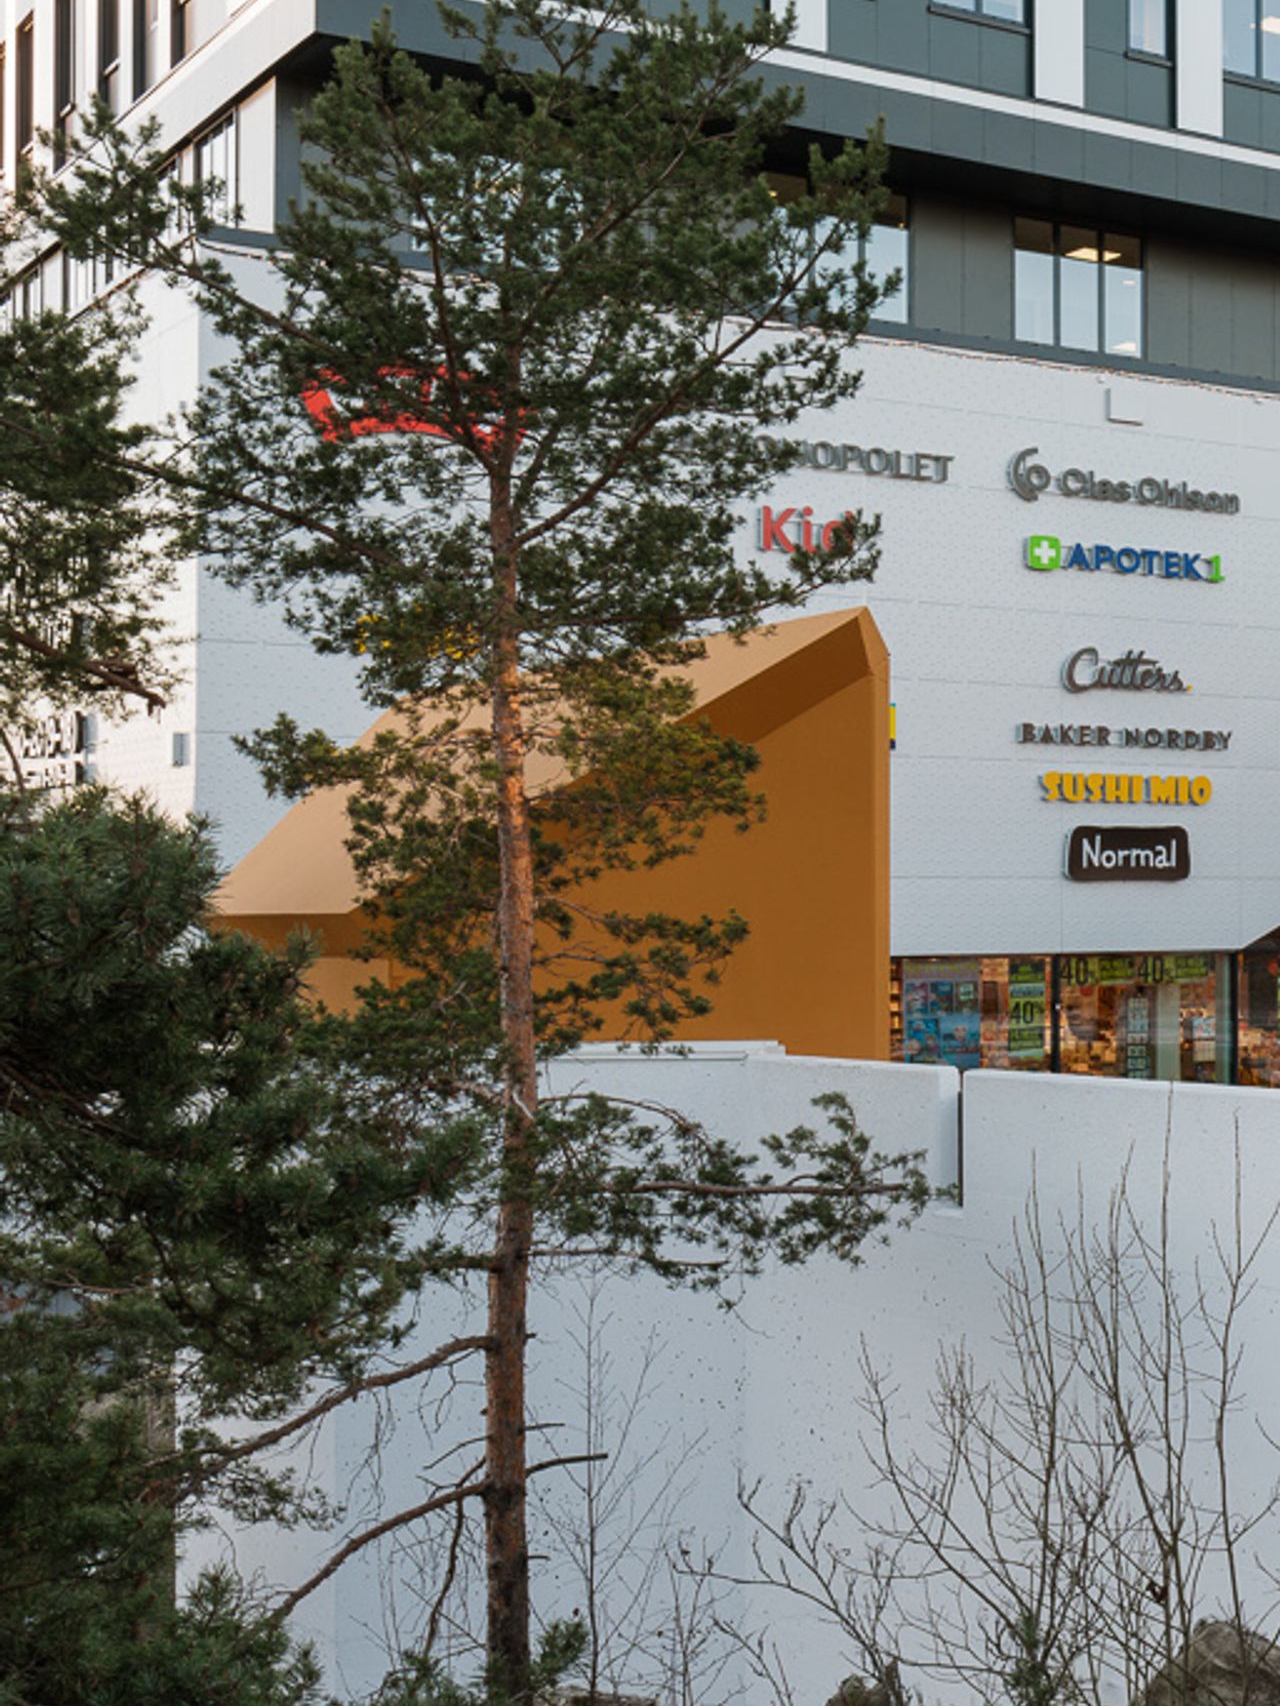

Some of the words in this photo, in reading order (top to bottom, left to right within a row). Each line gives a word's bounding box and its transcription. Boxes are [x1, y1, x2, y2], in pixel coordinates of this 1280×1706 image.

[1060, 467, 1132, 503] Clas
[1137, 477, 1241, 515] Ohlson
[1019, 722, 1111, 746] BAKER
[1123, 727, 1232, 751] NORDBY
[1042, 771, 1144, 803] SUSHI
[1149, 775, 1213, 805] MIO
[1081, 834, 1177, 869] Normal
